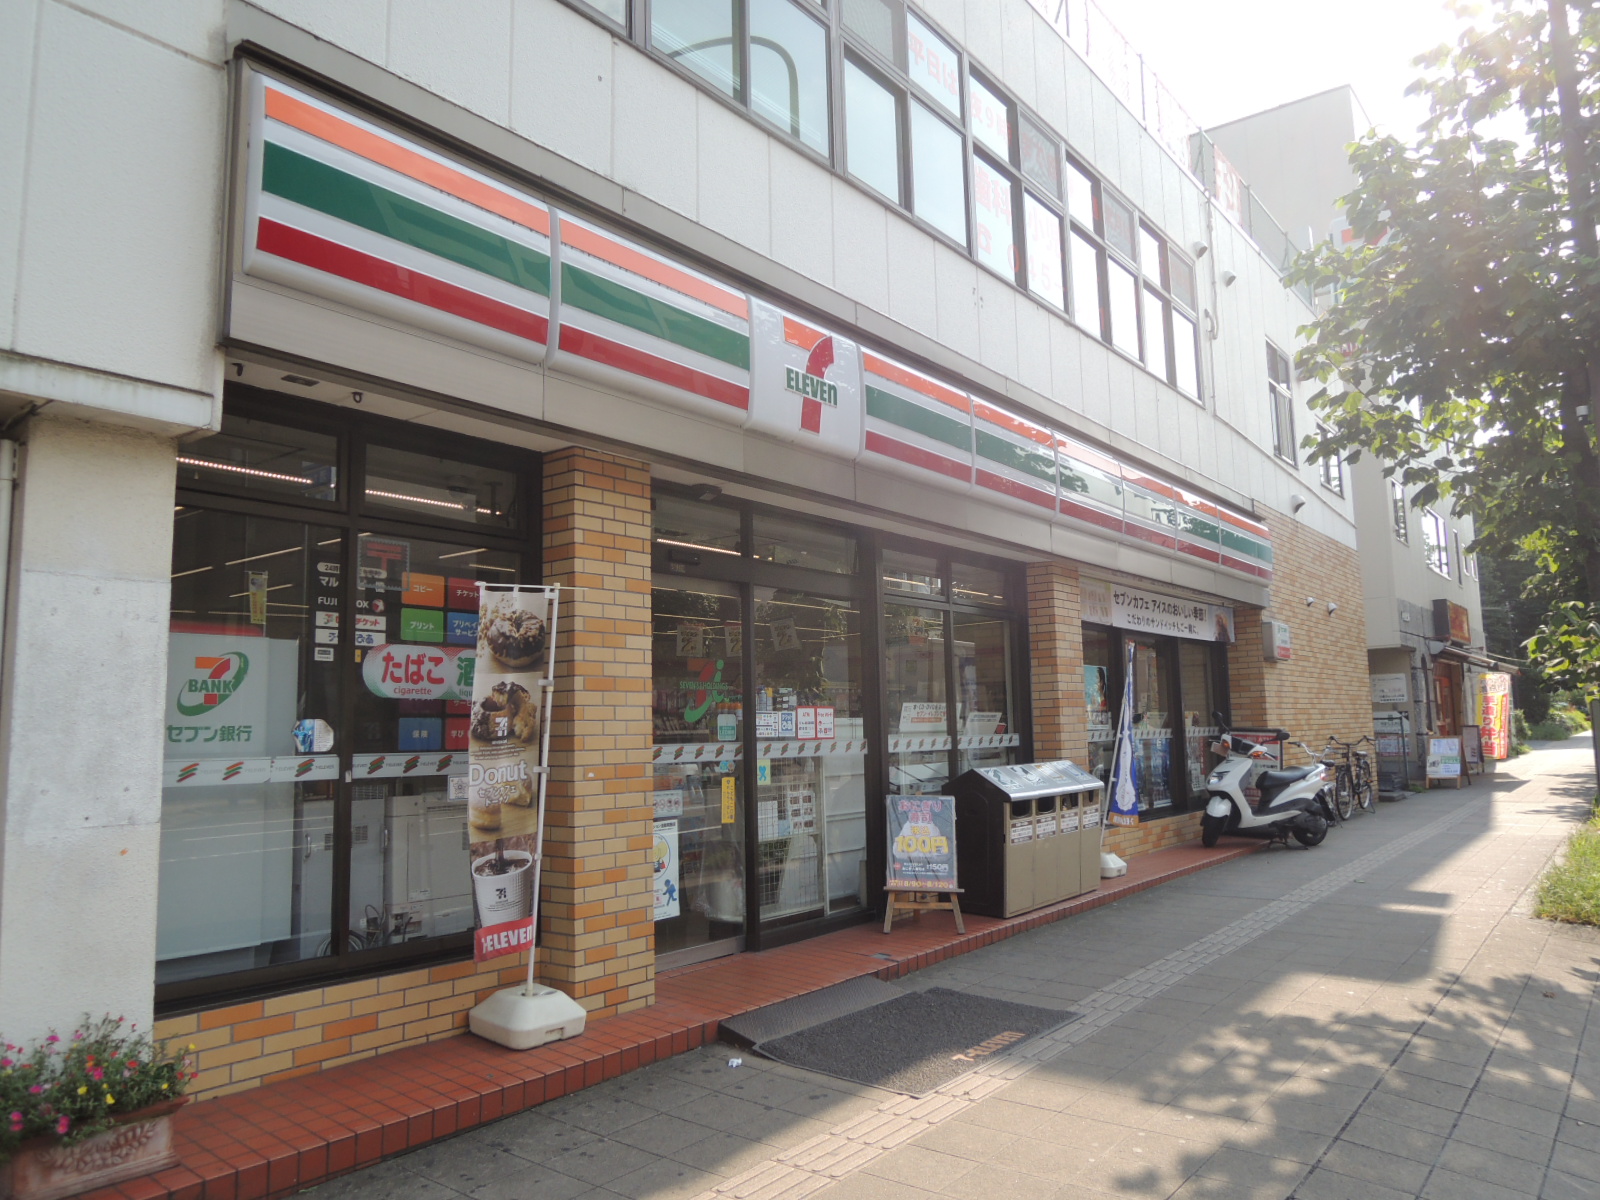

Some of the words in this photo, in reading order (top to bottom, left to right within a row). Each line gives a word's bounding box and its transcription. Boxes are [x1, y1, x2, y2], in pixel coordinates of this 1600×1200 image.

[318, 597, 338, 606] FUJI
[382, 651, 445, 685] たばこ
[188, 679, 233, 693] BANK
[393, 687, 432, 696] cigarette
[167, 725, 253, 743] セブン銀行
[469, 759, 528, 786] Donut
[896, 836, 949, 855] 100円
